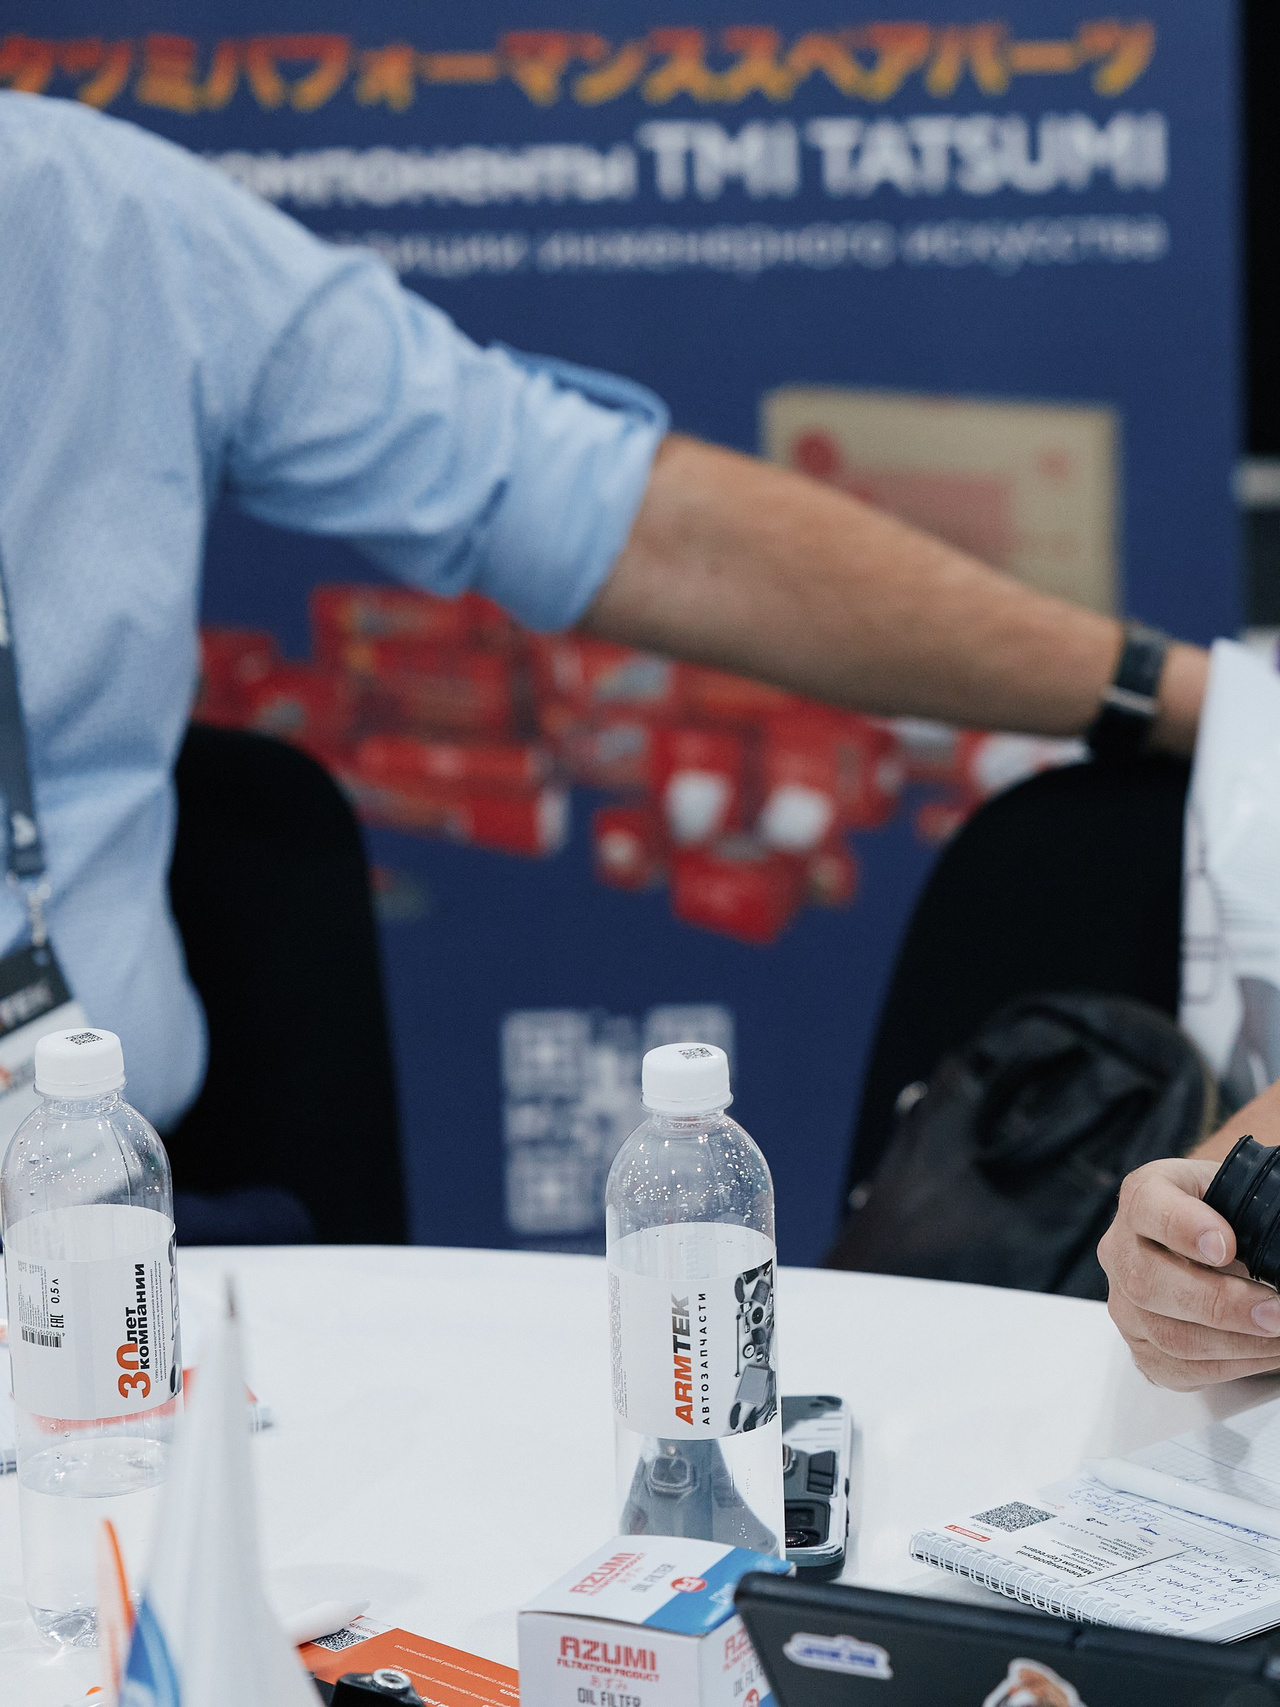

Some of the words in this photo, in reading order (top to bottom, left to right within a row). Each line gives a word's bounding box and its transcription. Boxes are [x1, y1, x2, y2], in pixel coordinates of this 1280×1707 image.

[210, 146, 637, 204] омпоненты
[807, 111, 1168, 195] TATSUMI
[50, 1287, 61, 1304] 0,5
[133, 1263, 151, 1370] компании
[124, 1307, 138, 1344] лет
[116, 1342, 151, 1399] 30
[670, 1292, 694, 1427] ARMTEK
[698, 1291, 711, 1427] АВТОЗАПЧАСТИ
[569, 1552, 636, 1594] AZUMI
[556, 1658, 612, 1674] FILTRATION
[613, 1668, 660, 1683] PRODUCT
[559, 1635, 658, 1673] AZUMI
[576, 1686, 598, 1705] OIL
[599, 1690, 642, 1707] FILTER
